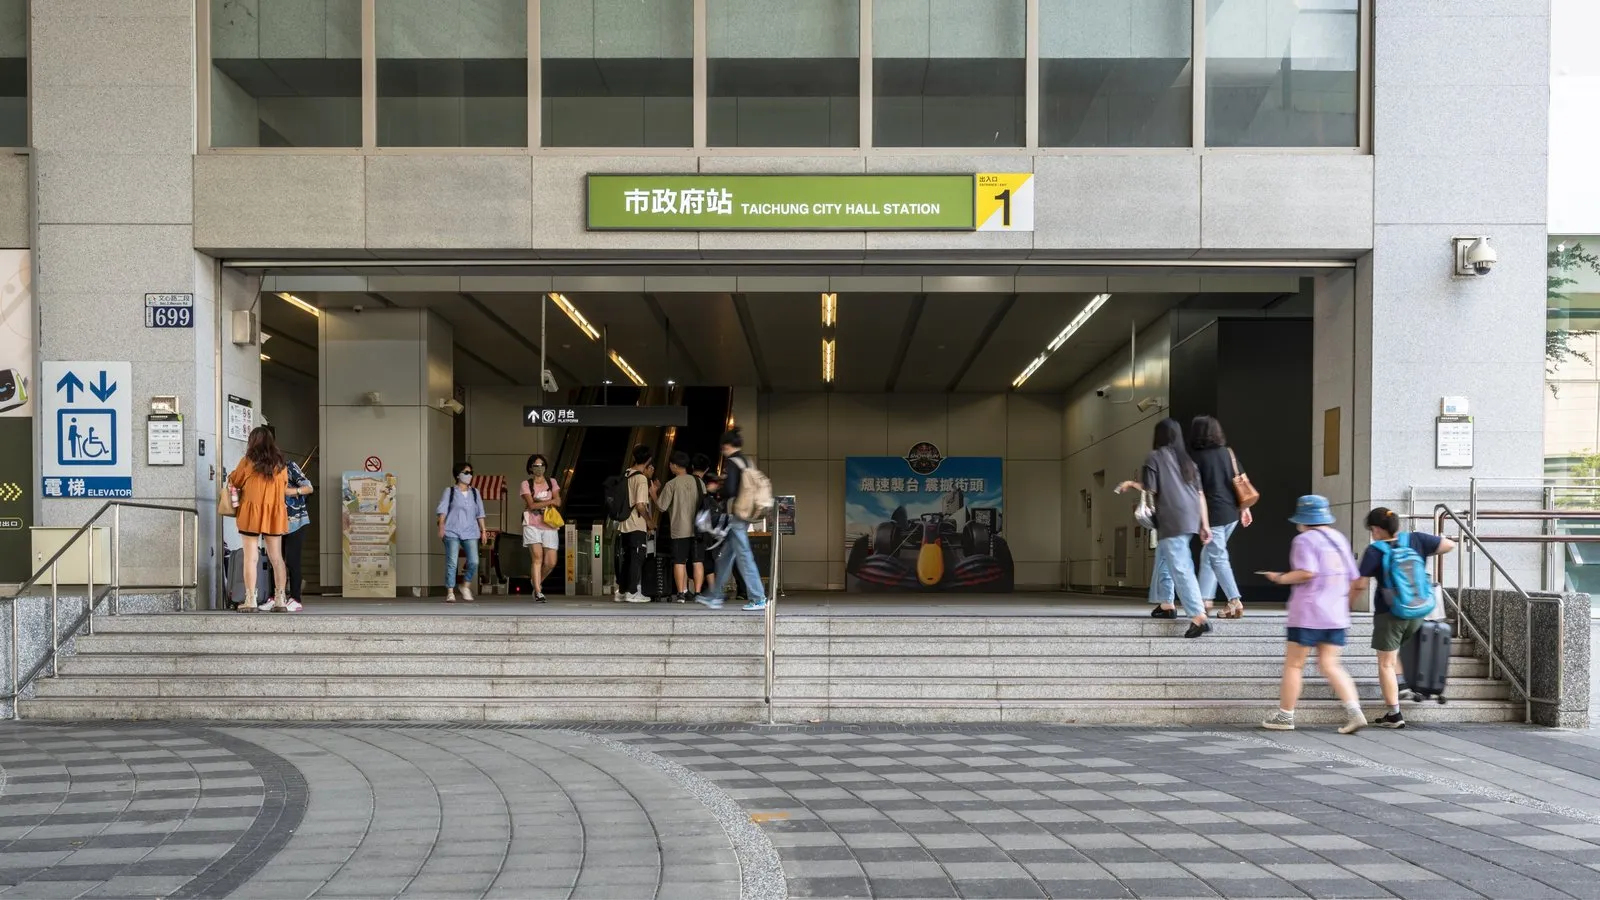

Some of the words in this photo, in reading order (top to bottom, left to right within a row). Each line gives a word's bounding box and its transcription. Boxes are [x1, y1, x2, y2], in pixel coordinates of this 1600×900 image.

[624, 188, 733, 215] 市政府站
[741, 203, 809, 215] TAICHUNG
[812, 203, 842, 215] CITY
[845, 203, 880, 215] HALL
[883, 203, 940, 215] STATION
[994, 189, 1010, 226] 1
[155, 307, 190, 326] 699
[558, 409, 574, 418] 月台
[45, 478, 85, 496] 電梯
[924, 477, 985, 492] 震撼街頭
